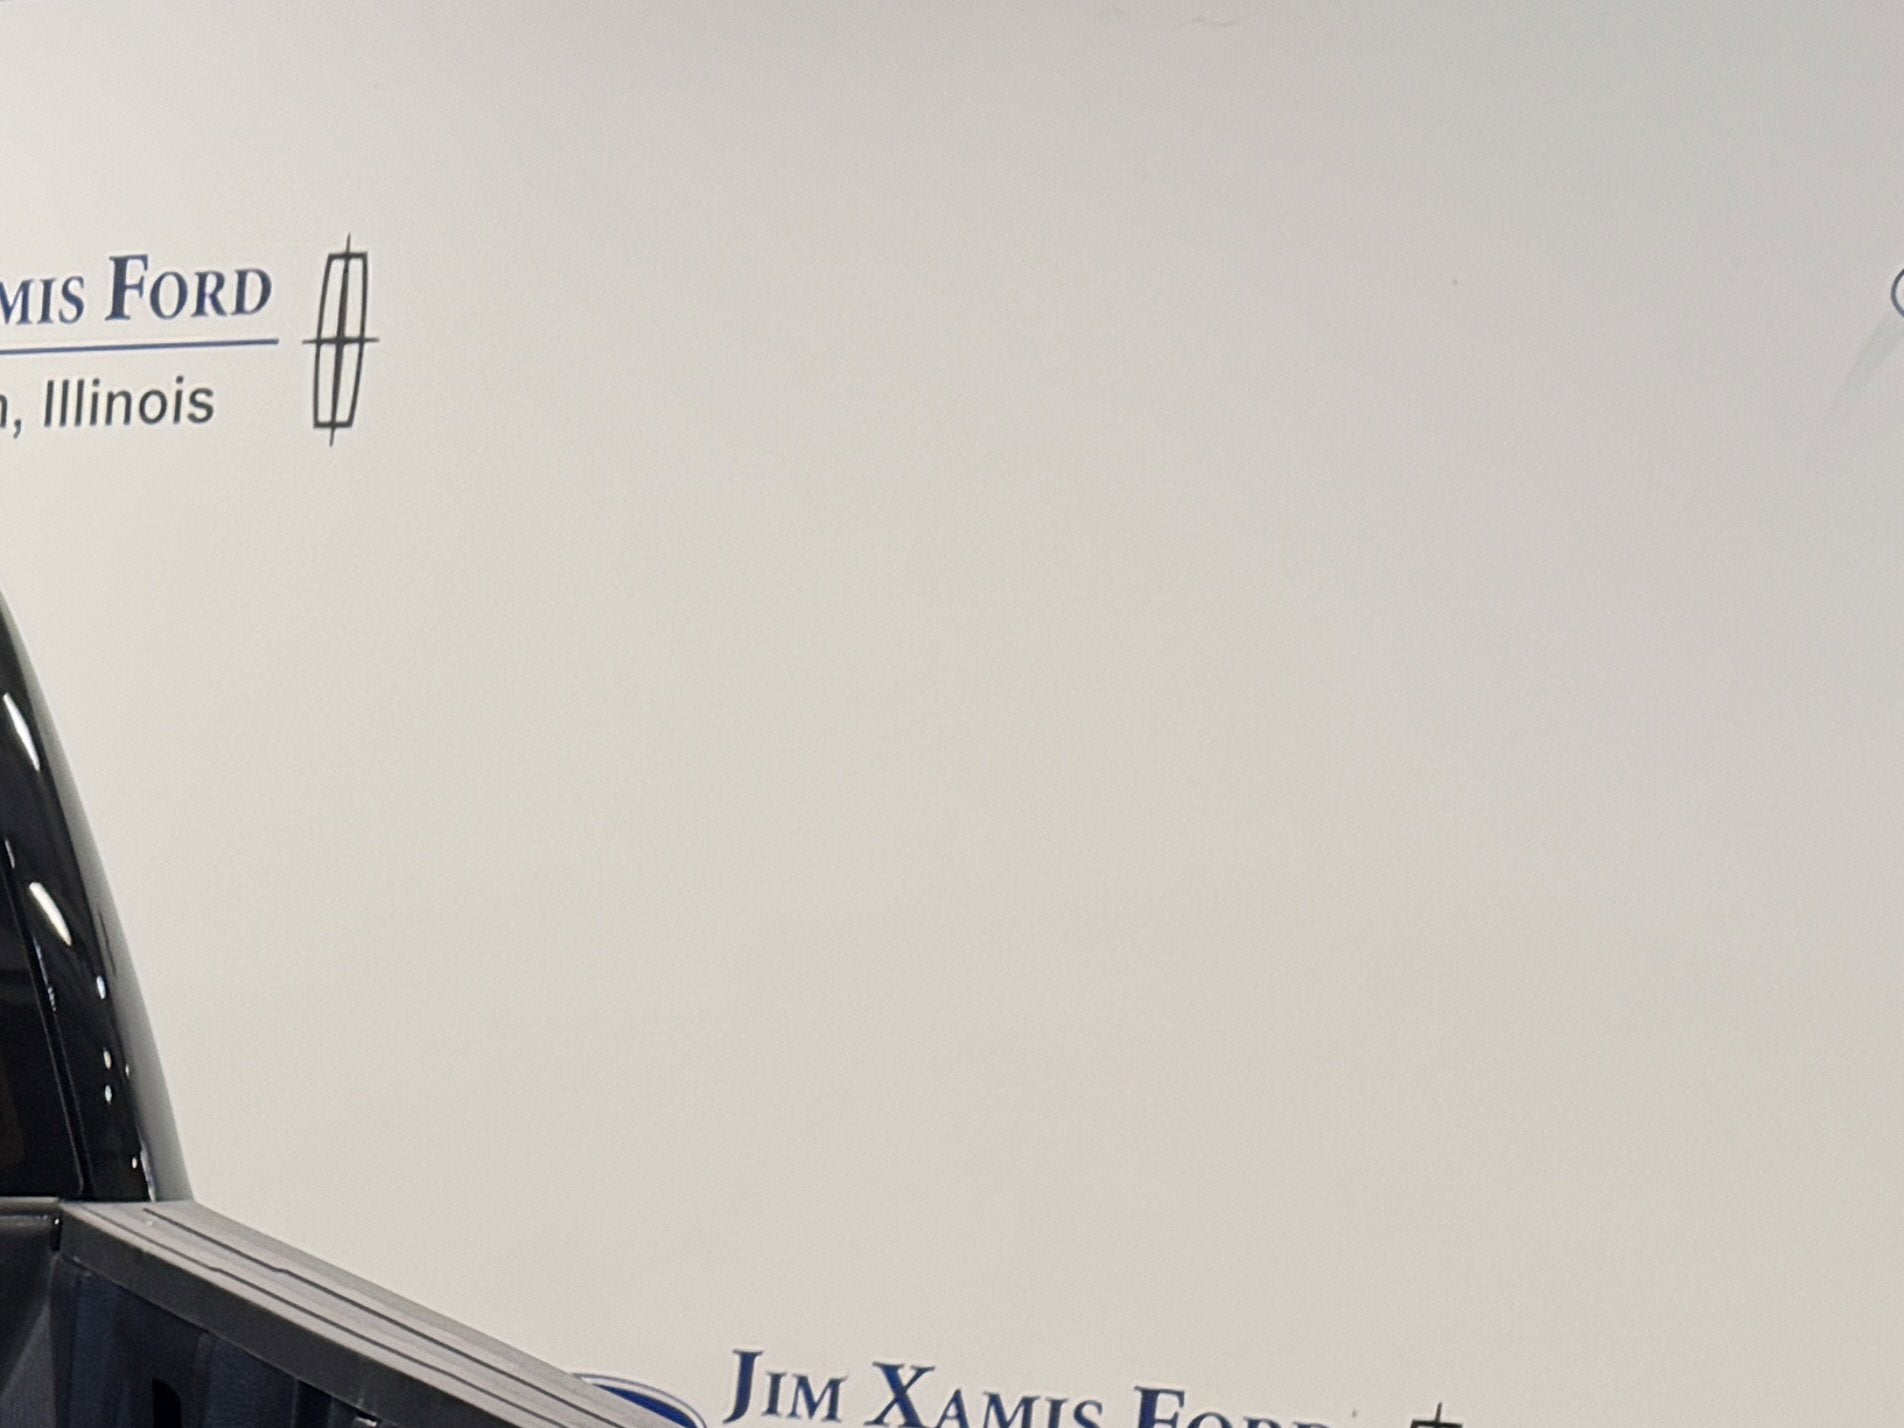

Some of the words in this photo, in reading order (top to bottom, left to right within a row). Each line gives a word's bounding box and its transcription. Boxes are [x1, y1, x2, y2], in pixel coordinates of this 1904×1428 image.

[104, 254, 272, 321] FORD
[44, 375, 214, 427] Illinois
[722, 1349, 848, 1424] JIM
